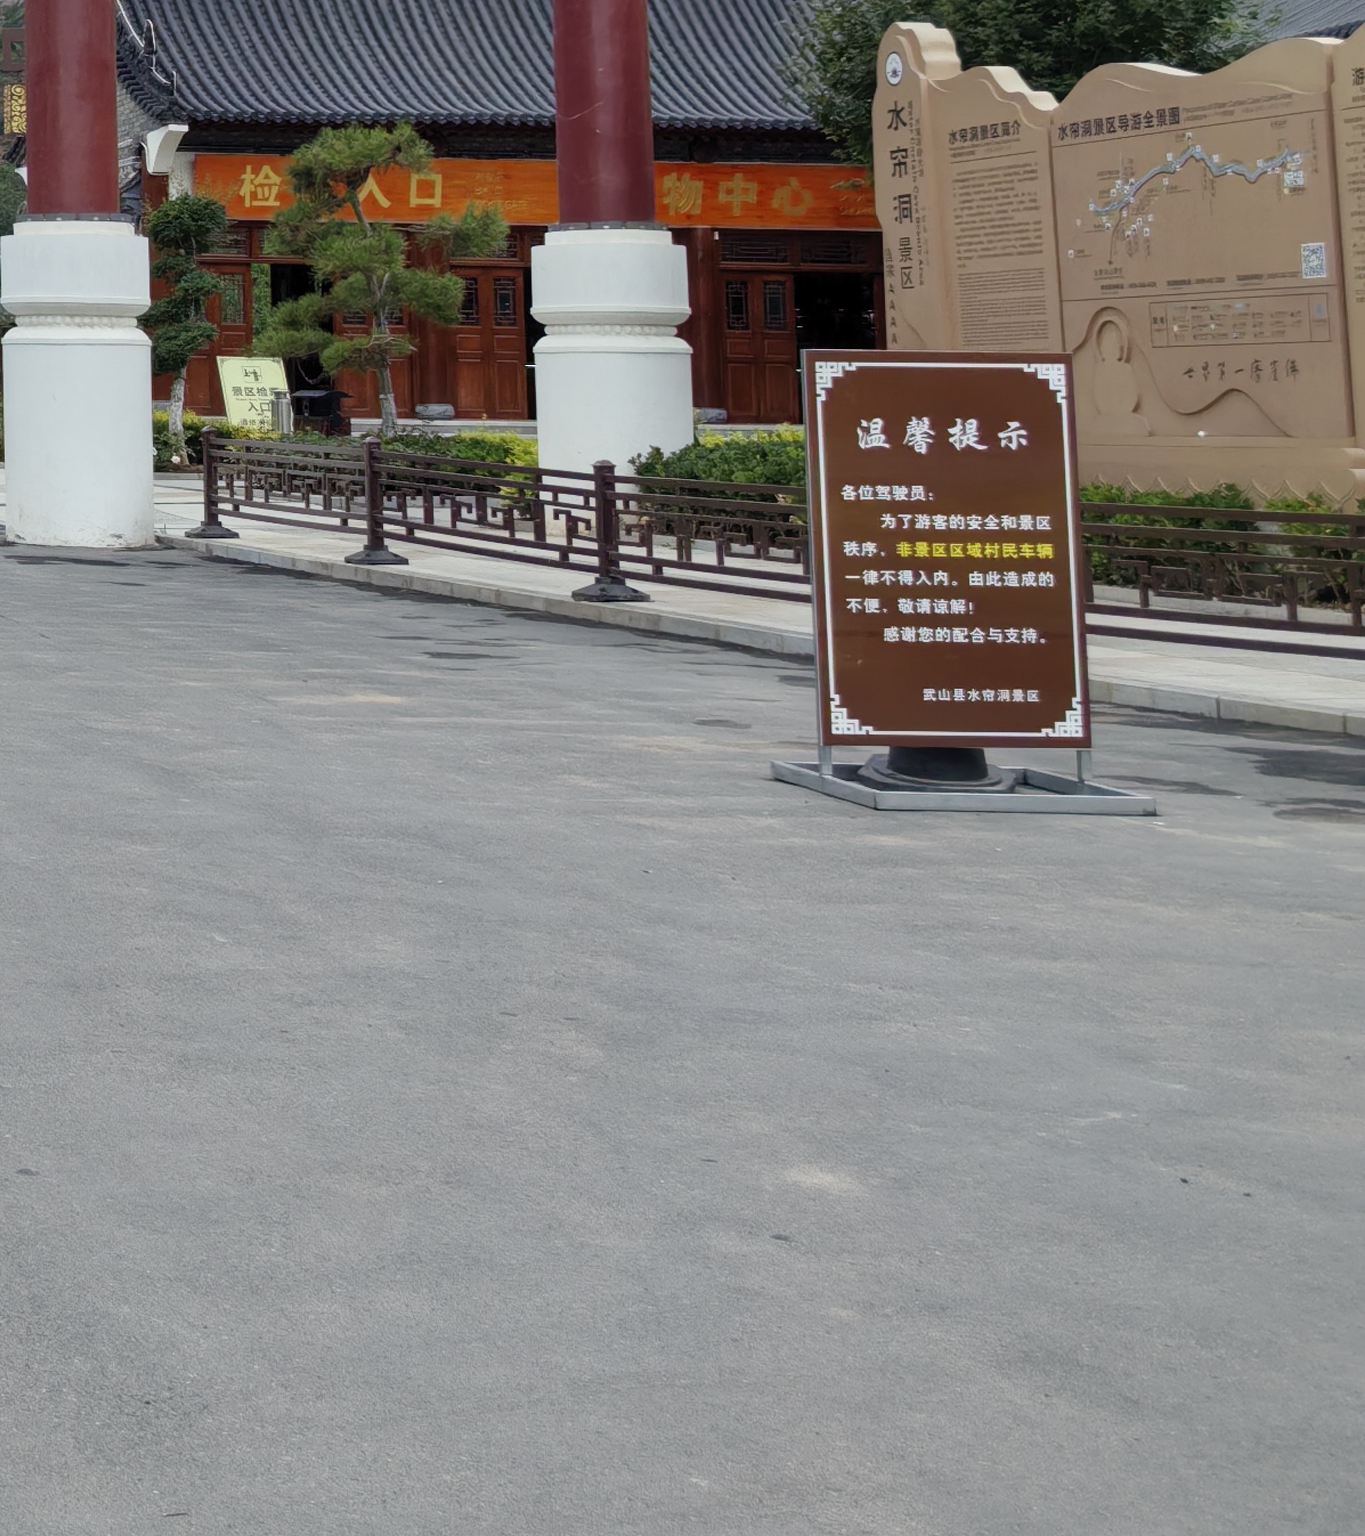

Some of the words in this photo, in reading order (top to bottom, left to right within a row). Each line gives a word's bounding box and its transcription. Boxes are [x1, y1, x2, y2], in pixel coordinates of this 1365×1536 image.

[1057, 106, 1180, 141] 水帘洞景区导游全景图
[239, 164, 443, 208] 检入口
[855, 417, 1030, 456] 温馨提示
[880, 513, 1053, 531] 为了游客的安全和景区
[844, 569, 1056, 588] 一律不得入内。由此造成的
[883, 626, 1050, 644] 感谢您的配合与支持。
[922, 688, 1040, 703] 武山县水帘洞景区
